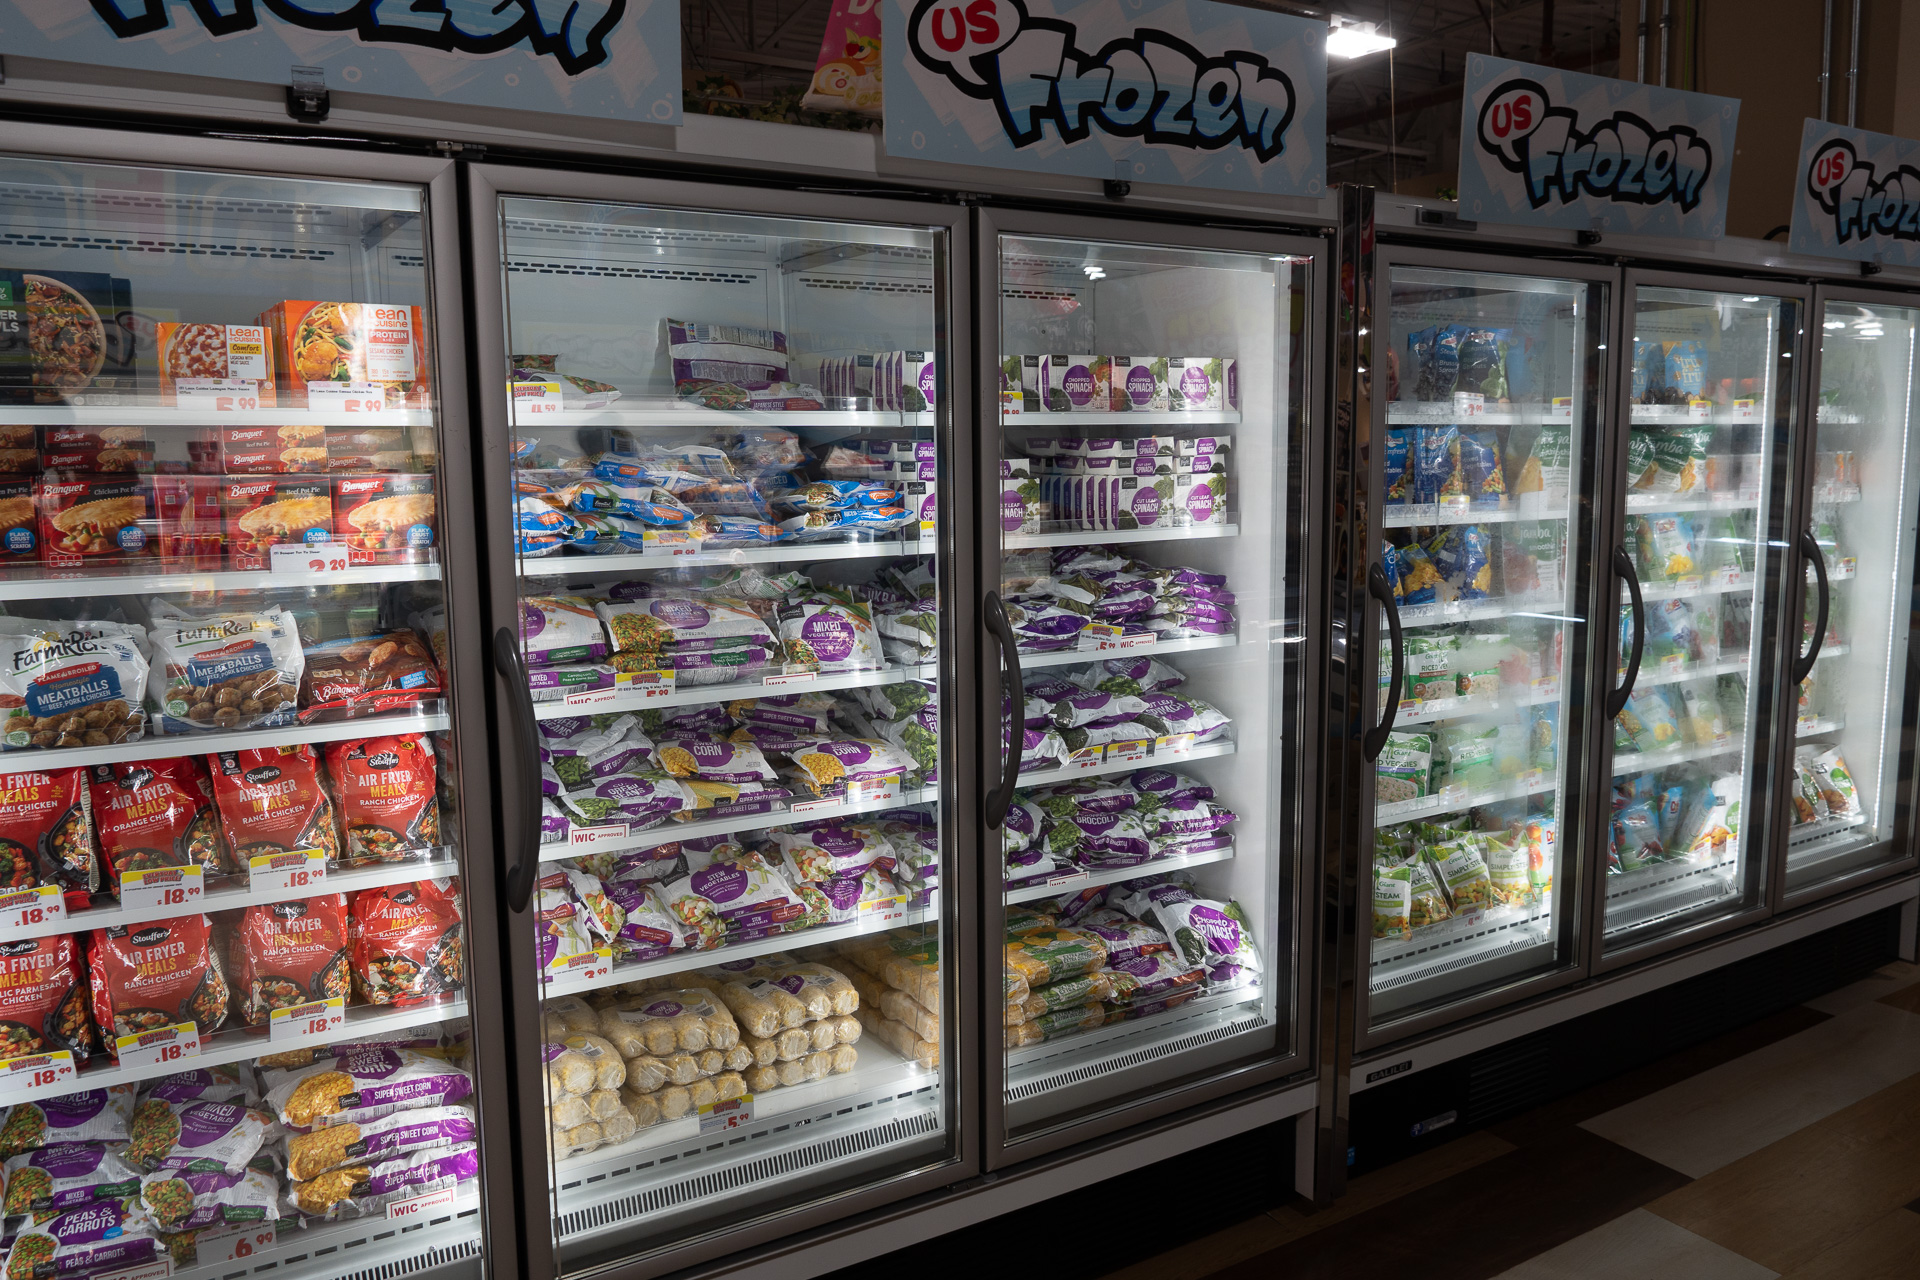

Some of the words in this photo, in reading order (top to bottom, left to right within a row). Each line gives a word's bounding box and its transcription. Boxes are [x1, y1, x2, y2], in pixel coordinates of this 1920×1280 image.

[931, 0, 1000, 52] US
[993, 17, 1296, 164] Frozen
[1491, 95, 1532, 138] US
[1523, 106, 1712, 214] Frozen
[1817, 151, 1845, 187] US
[1835, 161, 1920, 245] Froz
[229, 328, 261, 338] Lean
[370, 331, 408, 339] PROTEIN
[232, 344, 260, 352] Comfort
[1065, 383, 1093, 393] SPINACH
[1128, 383, 1154, 393] SPINACH
[1182, 383, 1207, 393] SPINACH
[53, 432, 85, 442] Banquet
[231, 430, 264, 440] Banquet
[51, 454, 84, 464] Banquet
[233, 454, 266, 465] Banquet
[43, 484, 86, 498] Banquet
[94, 487, 119, 496] Chicken
[230, 484, 273, 498] Banquet
[341, 480, 381, 494] Banquet
[1133, 503, 1159, 514] SPINACH
[1188, 500, 1212, 510] SPINACH
[1519, 526, 1551, 545] jamba
[660, 604, 691, 613] MIXED
[813, 620, 841, 631] MIXED
[807, 630, 849, 638] VEGETABLES
[226, 641, 258, 656] BROILED
[1120, 640, 1135, 649] WIC
[197, 654, 262, 678] MEATBALLS
[242, 663, 264, 674] CHICKEN
[1421, 664, 1438, 672] RICED
[37, 673, 61, 683] FLAME
[66, 664, 97, 677] BROILED
[403, 676, 425, 685] NATURAL
[531, 674, 548, 682] MIXED
[50, 678, 90, 690] Homestyle
[323, 684, 360, 698] Banquet
[404, 680, 426, 689] CHICKEN
[37, 679, 109, 706] MEATBALLS
[48, 701, 65, 711] BEEF,
[64, 697, 81, 707] PORK
[80, 695, 87, 703] &
[86, 689, 112, 703] CHICKEN
[282, 745, 297, 754] NEW!
[693, 745, 723, 756] CORN
[833, 745, 862, 756] CORN
[1386, 760, 1418, 768] VEGGIES
[7, 774, 50, 790] FRYER
[246, 767, 281, 783] Stouffer's
[358, 773, 376, 787] AIR
[378, 770, 412, 785] FRYER
[0, 787, 39, 805] MEALS
[111, 795, 134, 811] AIR
[135, 783, 174, 804] FRYER
[239, 787, 260, 803] AIR
[260, 779, 298, 798] FRYER
[370, 784, 407, 798] MEALS
[18, 800, 58, 812] CHICKEN
[253, 794, 291, 813] MEALS
[359, 798, 386, 806] RANCH
[386, 793, 420, 804] CHICKEN
[126, 798, 168, 820] MEALS
[242, 812, 270, 825] RANCH
[270, 804, 306, 818] CHICKEN
[717, 807, 730, 815] SUPER
[730, 805, 745, 814] SWEET
[745, 804, 760, 813] CORN
[113, 817, 148, 832] ORANGE
[149, 806, 185, 824] CHICKEN
[1077, 816, 1115, 825] BROCCOLI
[574, 832, 596, 843] WIC
[597, 831, 624, 839] APPROVED
[283, 869, 324, 888] $18.99
[706, 869, 726, 881] STEW
[1448, 865, 1470, 878] SIMPLY
[699, 871, 740, 892] VEGETABLES
[157, 887, 201, 906] $18.99
[15, 904, 60, 927] $18.99
[1196, 914, 1228, 927] CHOPPED
[132, 929, 168, 945] Stouffer's
[1194, 923, 1236, 940] SPINACH
[123, 953, 145, 968] AIR
[146, 941, 186, 962] FRYER
[136, 957, 177, 977] MEALS
[15, 980, 62, 995] PARMESAN
[302, 1015, 342, 1035] $18.99
[155, 1041, 197, 1063] $18.99
[28, 1066, 72, 1087] $18.99
[1370, 1063, 1409, 1082] GALILEI
[373, 1086, 394, 1100] SUPER
[394, 1084, 415, 1096] SWEET
[414, 1081, 432, 1092] CORN
[203, 1102, 236, 1116] MIXED
[188, 1110, 235, 1123] VEGETABLES
[722, 1113, 749, 1130] $5.99
[380, 1132, 399, 1145] SUPER
[400, 1128, 421, 1140] SWEET
[421, 1125, 439, 1136] CORN
[65, 1189, 85, 1201] MIXED
[393, 1203, 419, 1217] WIC
[420, 1196, 450, 1208] APPROVED
[65, 1209, 97, 1224] PEAS
[100, 1207, 113, 1217] &
[57, 1214, 116, 1238] CARROTS
[65, 1255, 84, 1269] PEAS
[84, 1253, 93, 1264] &
[93, 1246, 126, 1263] CARROTS
[130, 1268, 166, 1280] APPROVED
